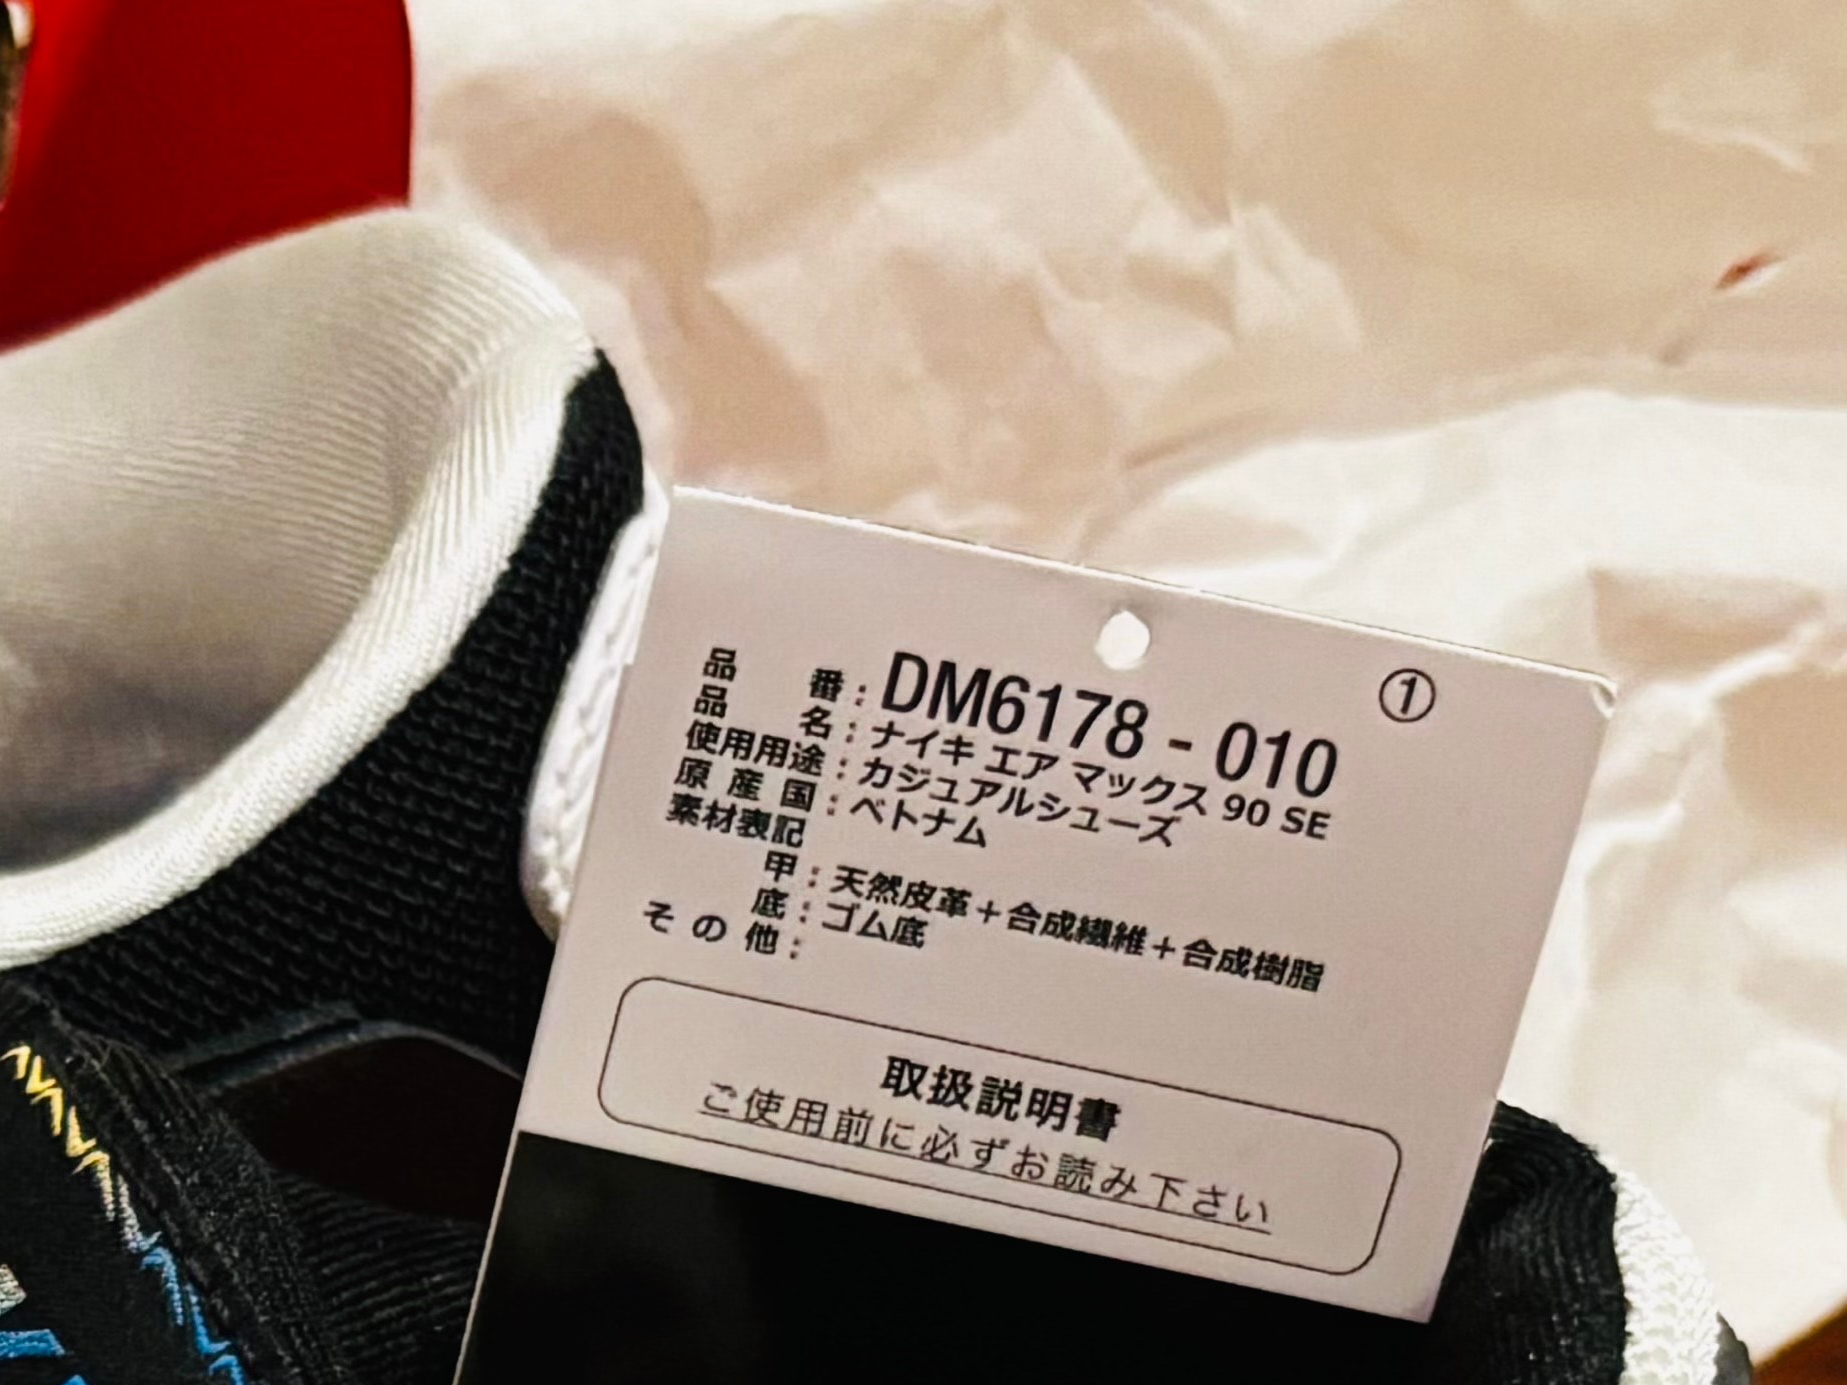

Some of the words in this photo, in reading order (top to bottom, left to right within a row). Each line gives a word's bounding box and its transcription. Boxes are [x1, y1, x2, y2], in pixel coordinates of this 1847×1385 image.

[881, 650, 1149, 759] DM6178
[1214, 720, 1338, 799] 010
[665, 792, 807, 849] 素材表記
[850, 797, 988, 849] ベトナム
[857, 756, 1181, 848] カジュアルシューズ
[870, 720, 976, 767] ナイキ
[984, 744, 1060, 781] エア
[1071, 760, 1209, 816] マックス
[1221, 793, 1271, 828] 90
[1279, 805, 1332, 841] SE
[821, 901, 929, 950] ゴム底
[879, 1055, 1122, 1143] 取扱説明書
[702, 1081, 1269, 1226] ご使用前に必ずお読み下さい
